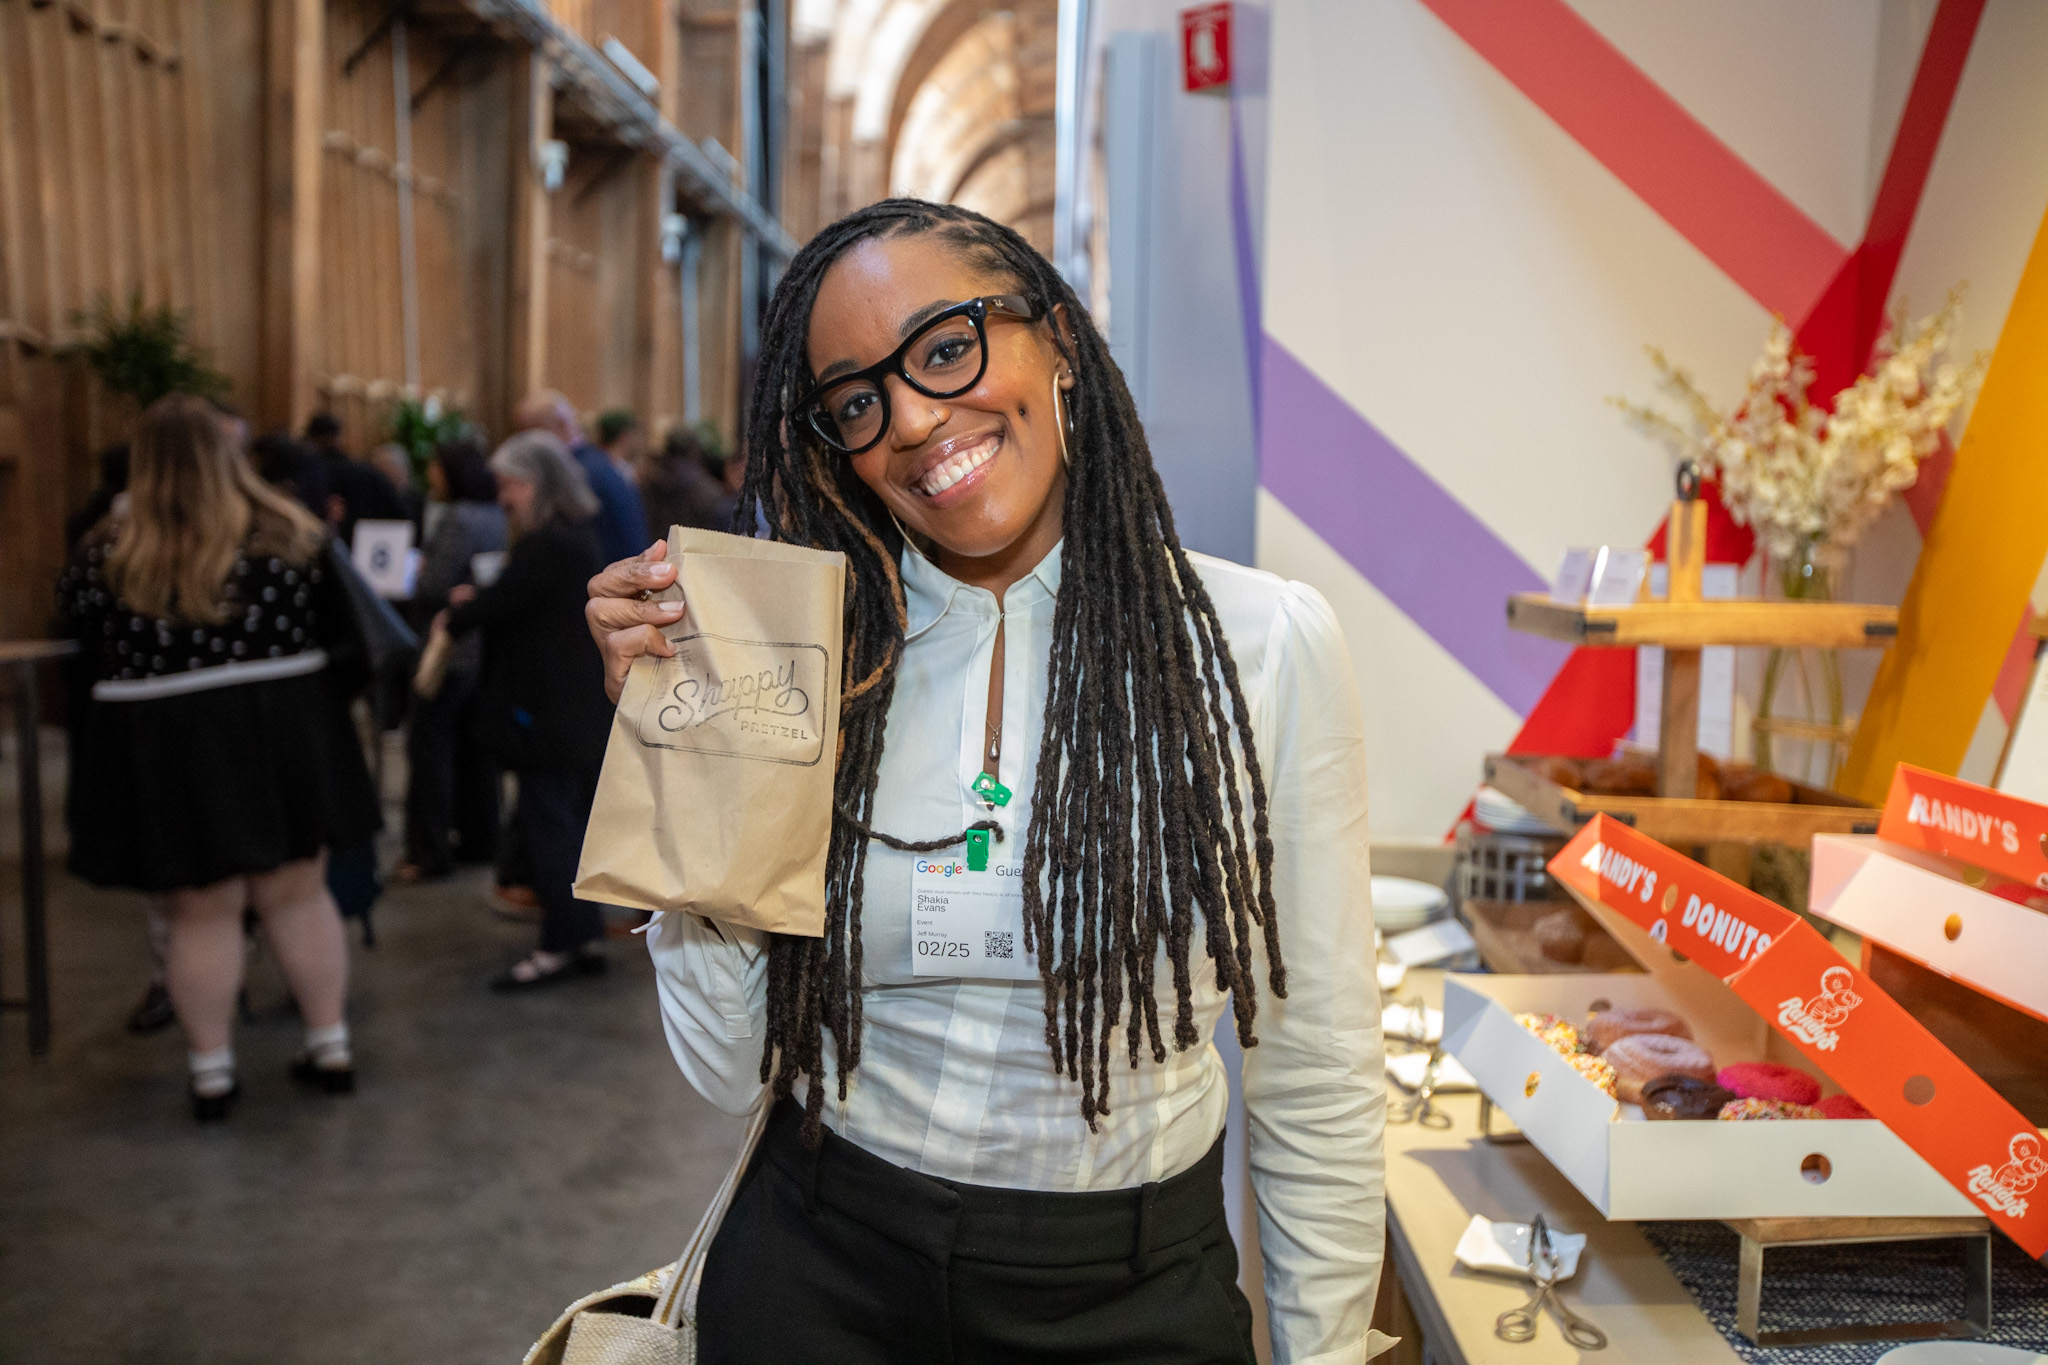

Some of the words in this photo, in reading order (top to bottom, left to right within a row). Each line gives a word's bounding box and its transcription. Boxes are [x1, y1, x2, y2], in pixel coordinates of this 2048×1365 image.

[740, 720, 808, 740] PRETZEL
[1907, 792, 2020, 854] RANDY'S
[916, 860, 963, 878] Google
[995, 865, 1022, 877] Gue
[1580, 841, 1658, 903] RANDY'S
[917, 894, 949, 905] Shakia
[917, 902, 946, 913] Evans
[928, 931, 948, 939] Murray
[1681, 893, 1772, 961] DONUTS
[918, 940, 970, 958] 02/25
[1778, 996, 1840, 1052] Randy's
[1967, 1163, 2029, 1219] Randy's
